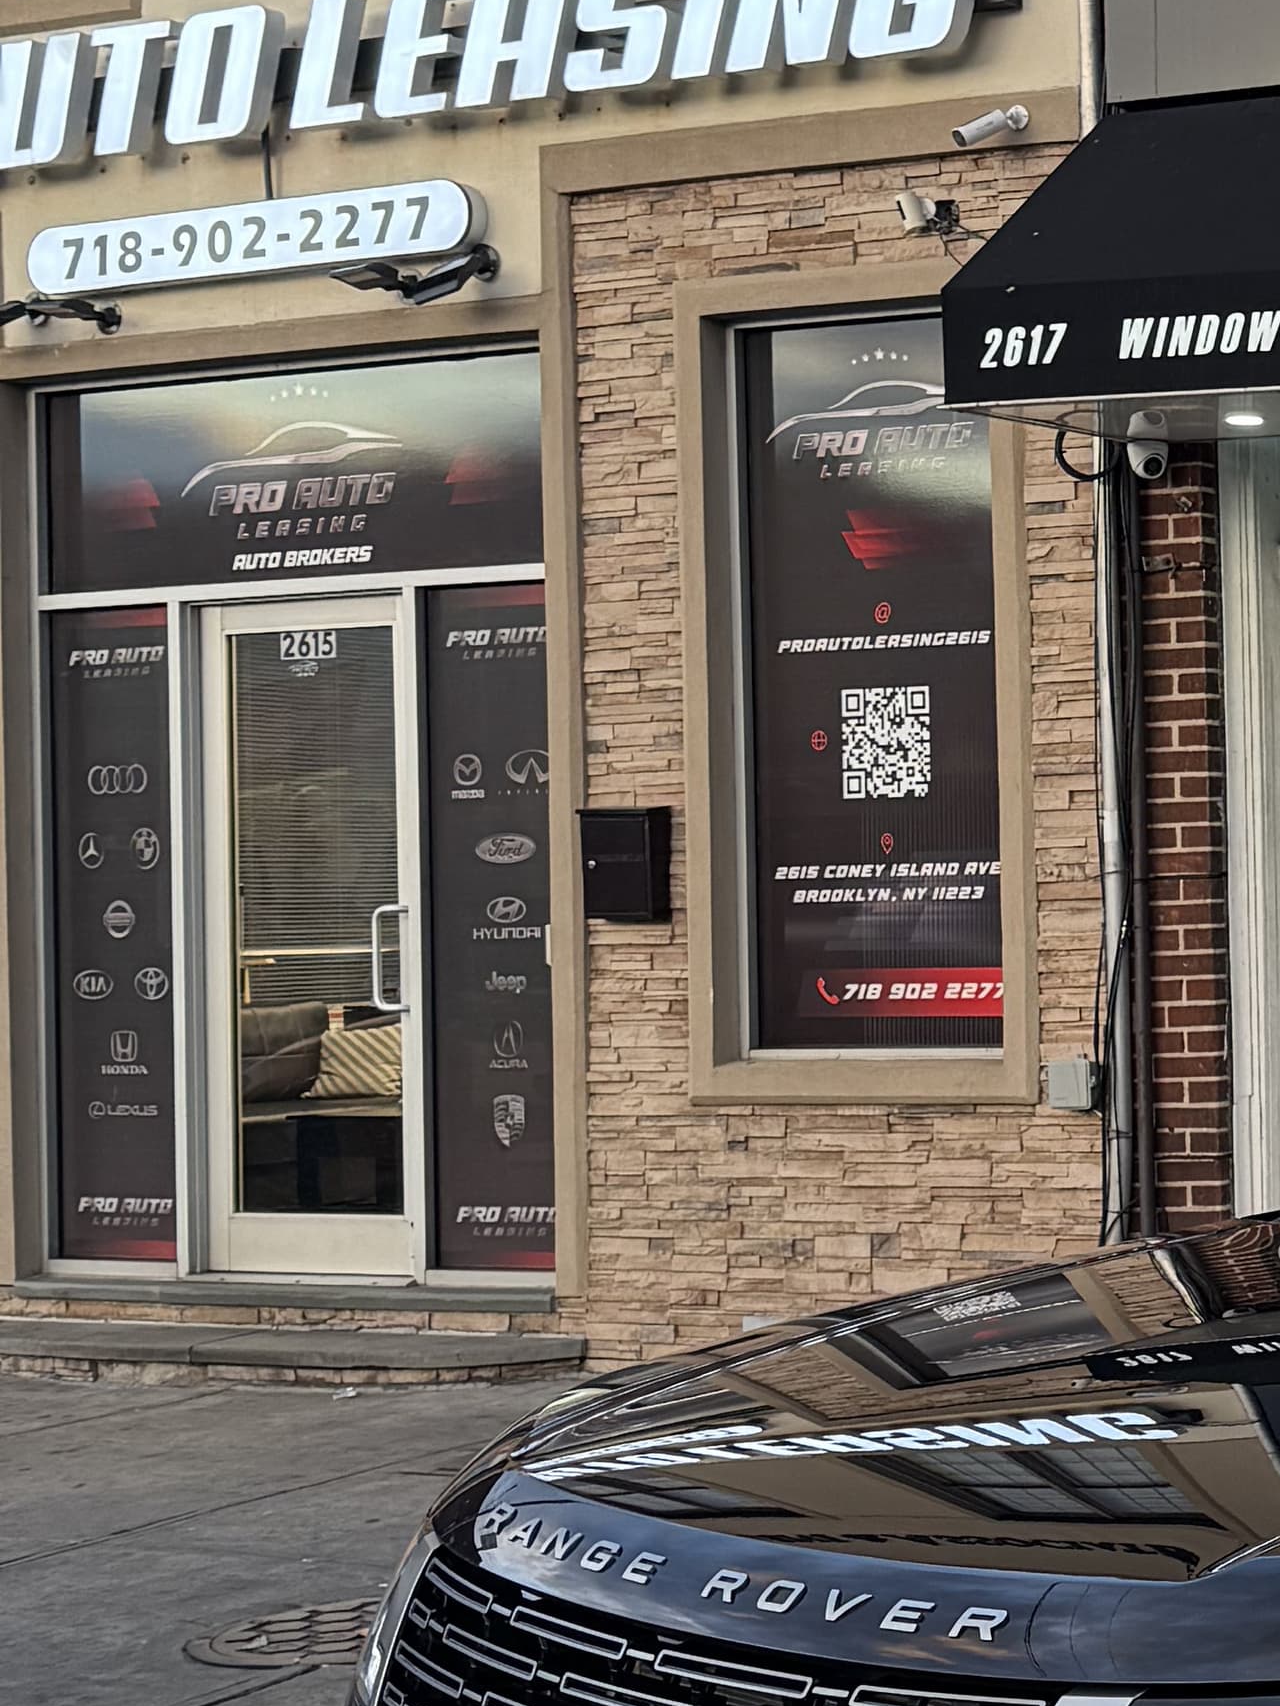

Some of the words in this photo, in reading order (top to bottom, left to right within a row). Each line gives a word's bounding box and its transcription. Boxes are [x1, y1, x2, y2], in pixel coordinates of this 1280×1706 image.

[62, 195, 430, 281] 718-902-2277
[979, 323, 1068, 369] 2617
[792, 429, 869, 460] PRO
[208, 480, 288, 517] PRO
[292, 472, 396, 509] AUTO
[237, 514, 368, 540] LEASING
[232, 552, 281, 571] AUTO
[283, 545, 373, 568] BROKERS
[283, 632, 333, 658] 2615
[446, 629, 491, 647] PRO
[69, 648, 109, 666] PRO
[111, 645, 165, 664] AUTO
[488, 838, 523, 857] Ford
[774, 865, 820, 880] 2615
[823, 863, 885, 880] CONEY
[890, 862, 958, 877] ISLAND
[964, 861, 1001, 876] AVE
[902, 887, 929, 901] NY
[473, 926, 541, 940] HYUNDAI
[80, 976, 106, 993] KIA
[486, 971, 527, 994] Jeep
[842, 983, 883, 1001] 718
[888, 982, 935, 1000] 902
[944, 981, 1004, 1000] 2277
[101, 1065, 149, 1075] HONDA
[489, 1058, 528, 1069] ACURA
[106, 1104, 159, 1117] LEXUS
[78, 1196, 119, 1213] PRO
[121, 1197, 173, 1214] AUTO
[456, 1205, 502, 1223] PRO
[482, 1502, 667, 1585] RANGE
[701, 1569, 1009, 1642] ROVER
